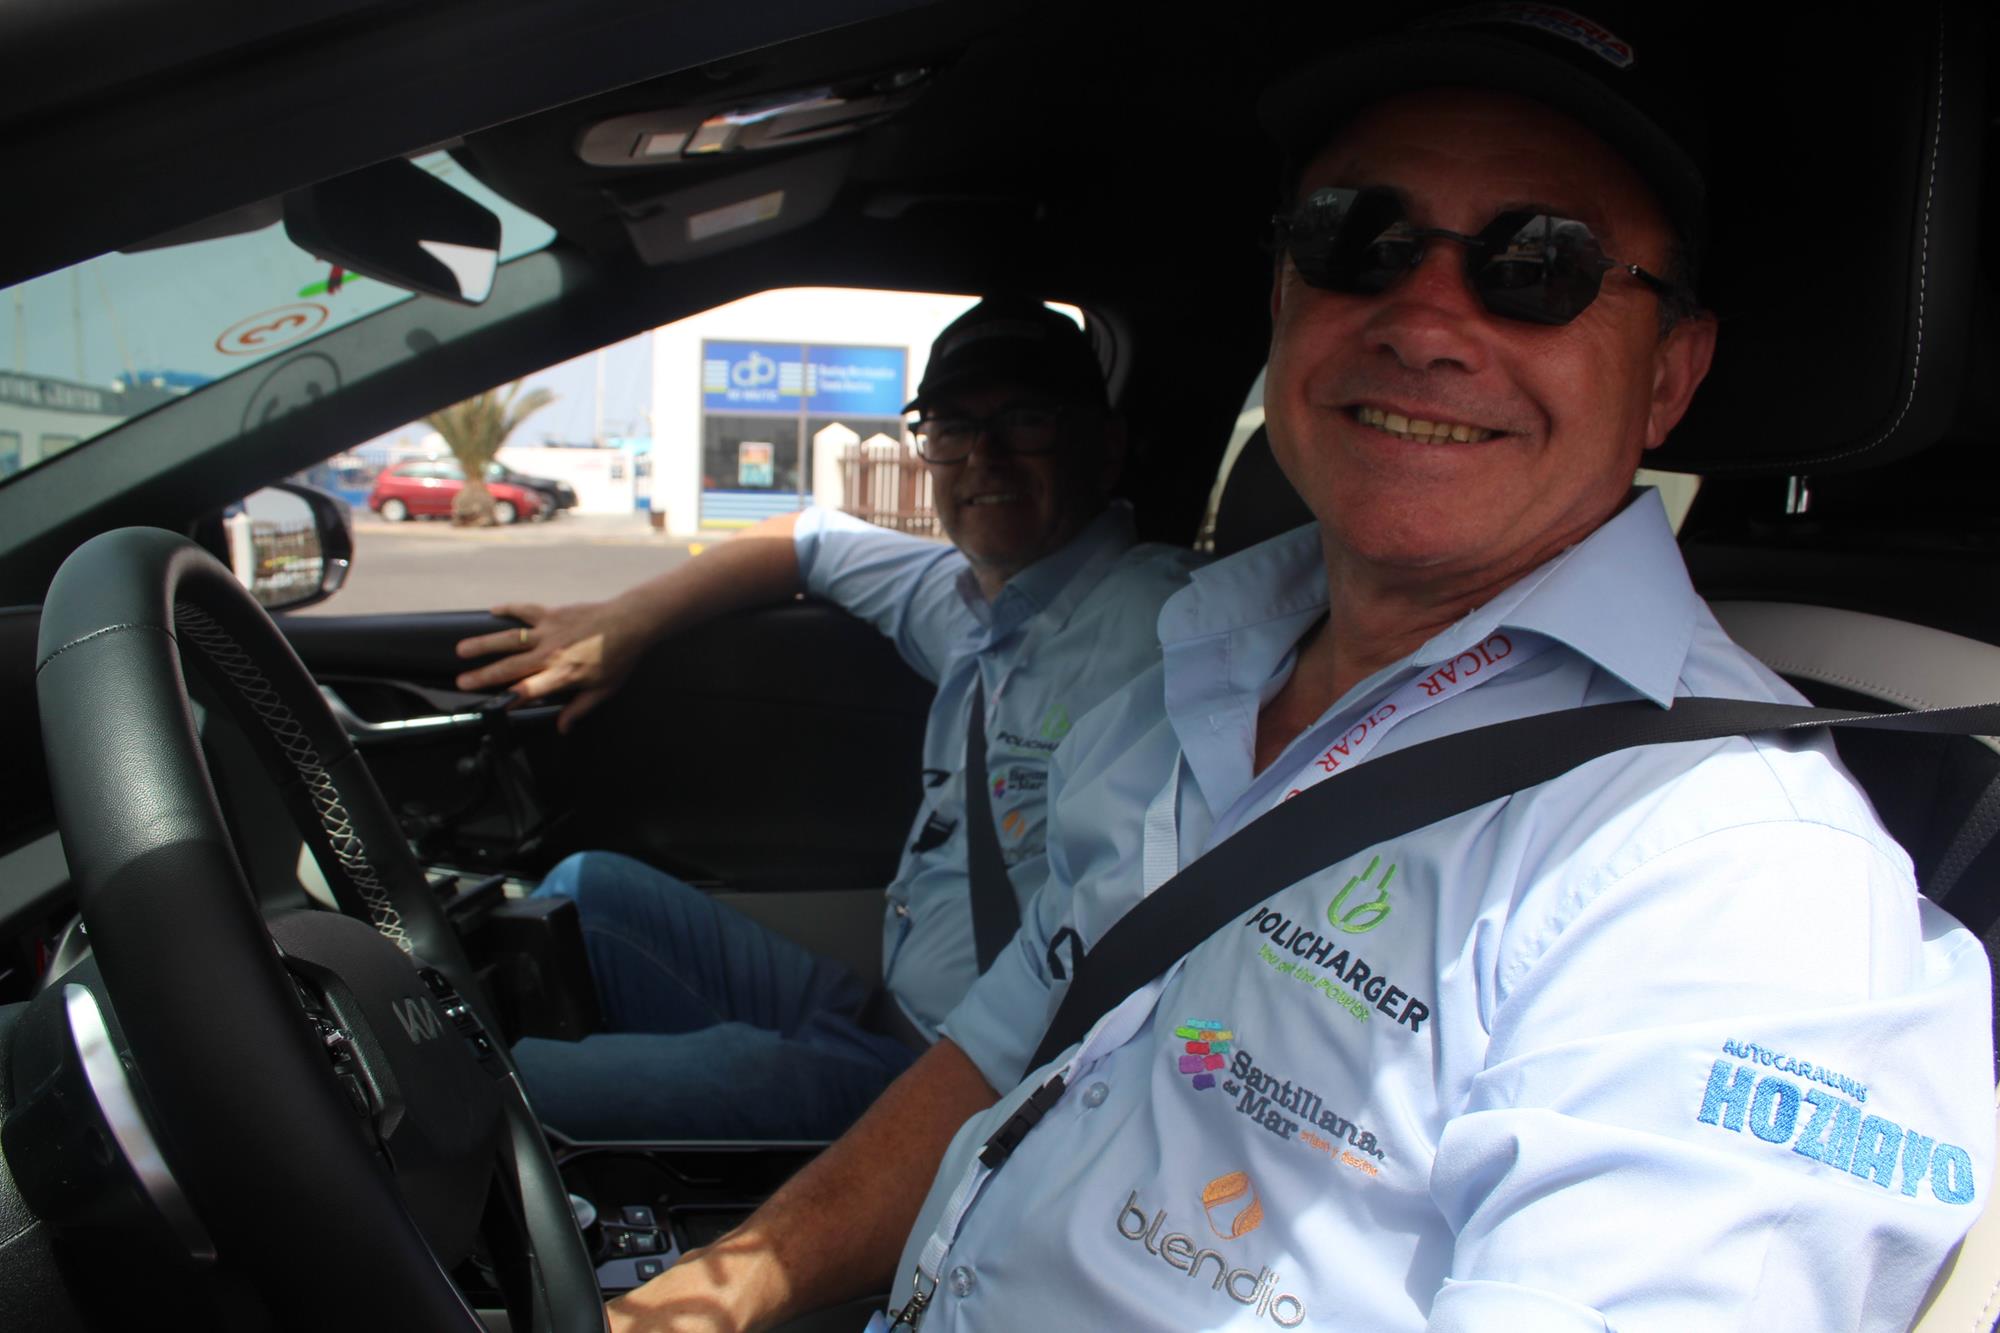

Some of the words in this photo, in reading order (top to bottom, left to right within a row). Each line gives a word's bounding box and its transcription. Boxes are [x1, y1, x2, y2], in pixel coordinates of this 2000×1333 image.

[1416, 634, 1513, 697] CICAR
[1315, 703, 1397, 773] CICAR
[1244, 906, 1430, 1033] POLICHARGER
[1235, 1084, 1299, 1141] Mar
[1116, 1189, 1306, 1328] blendio
